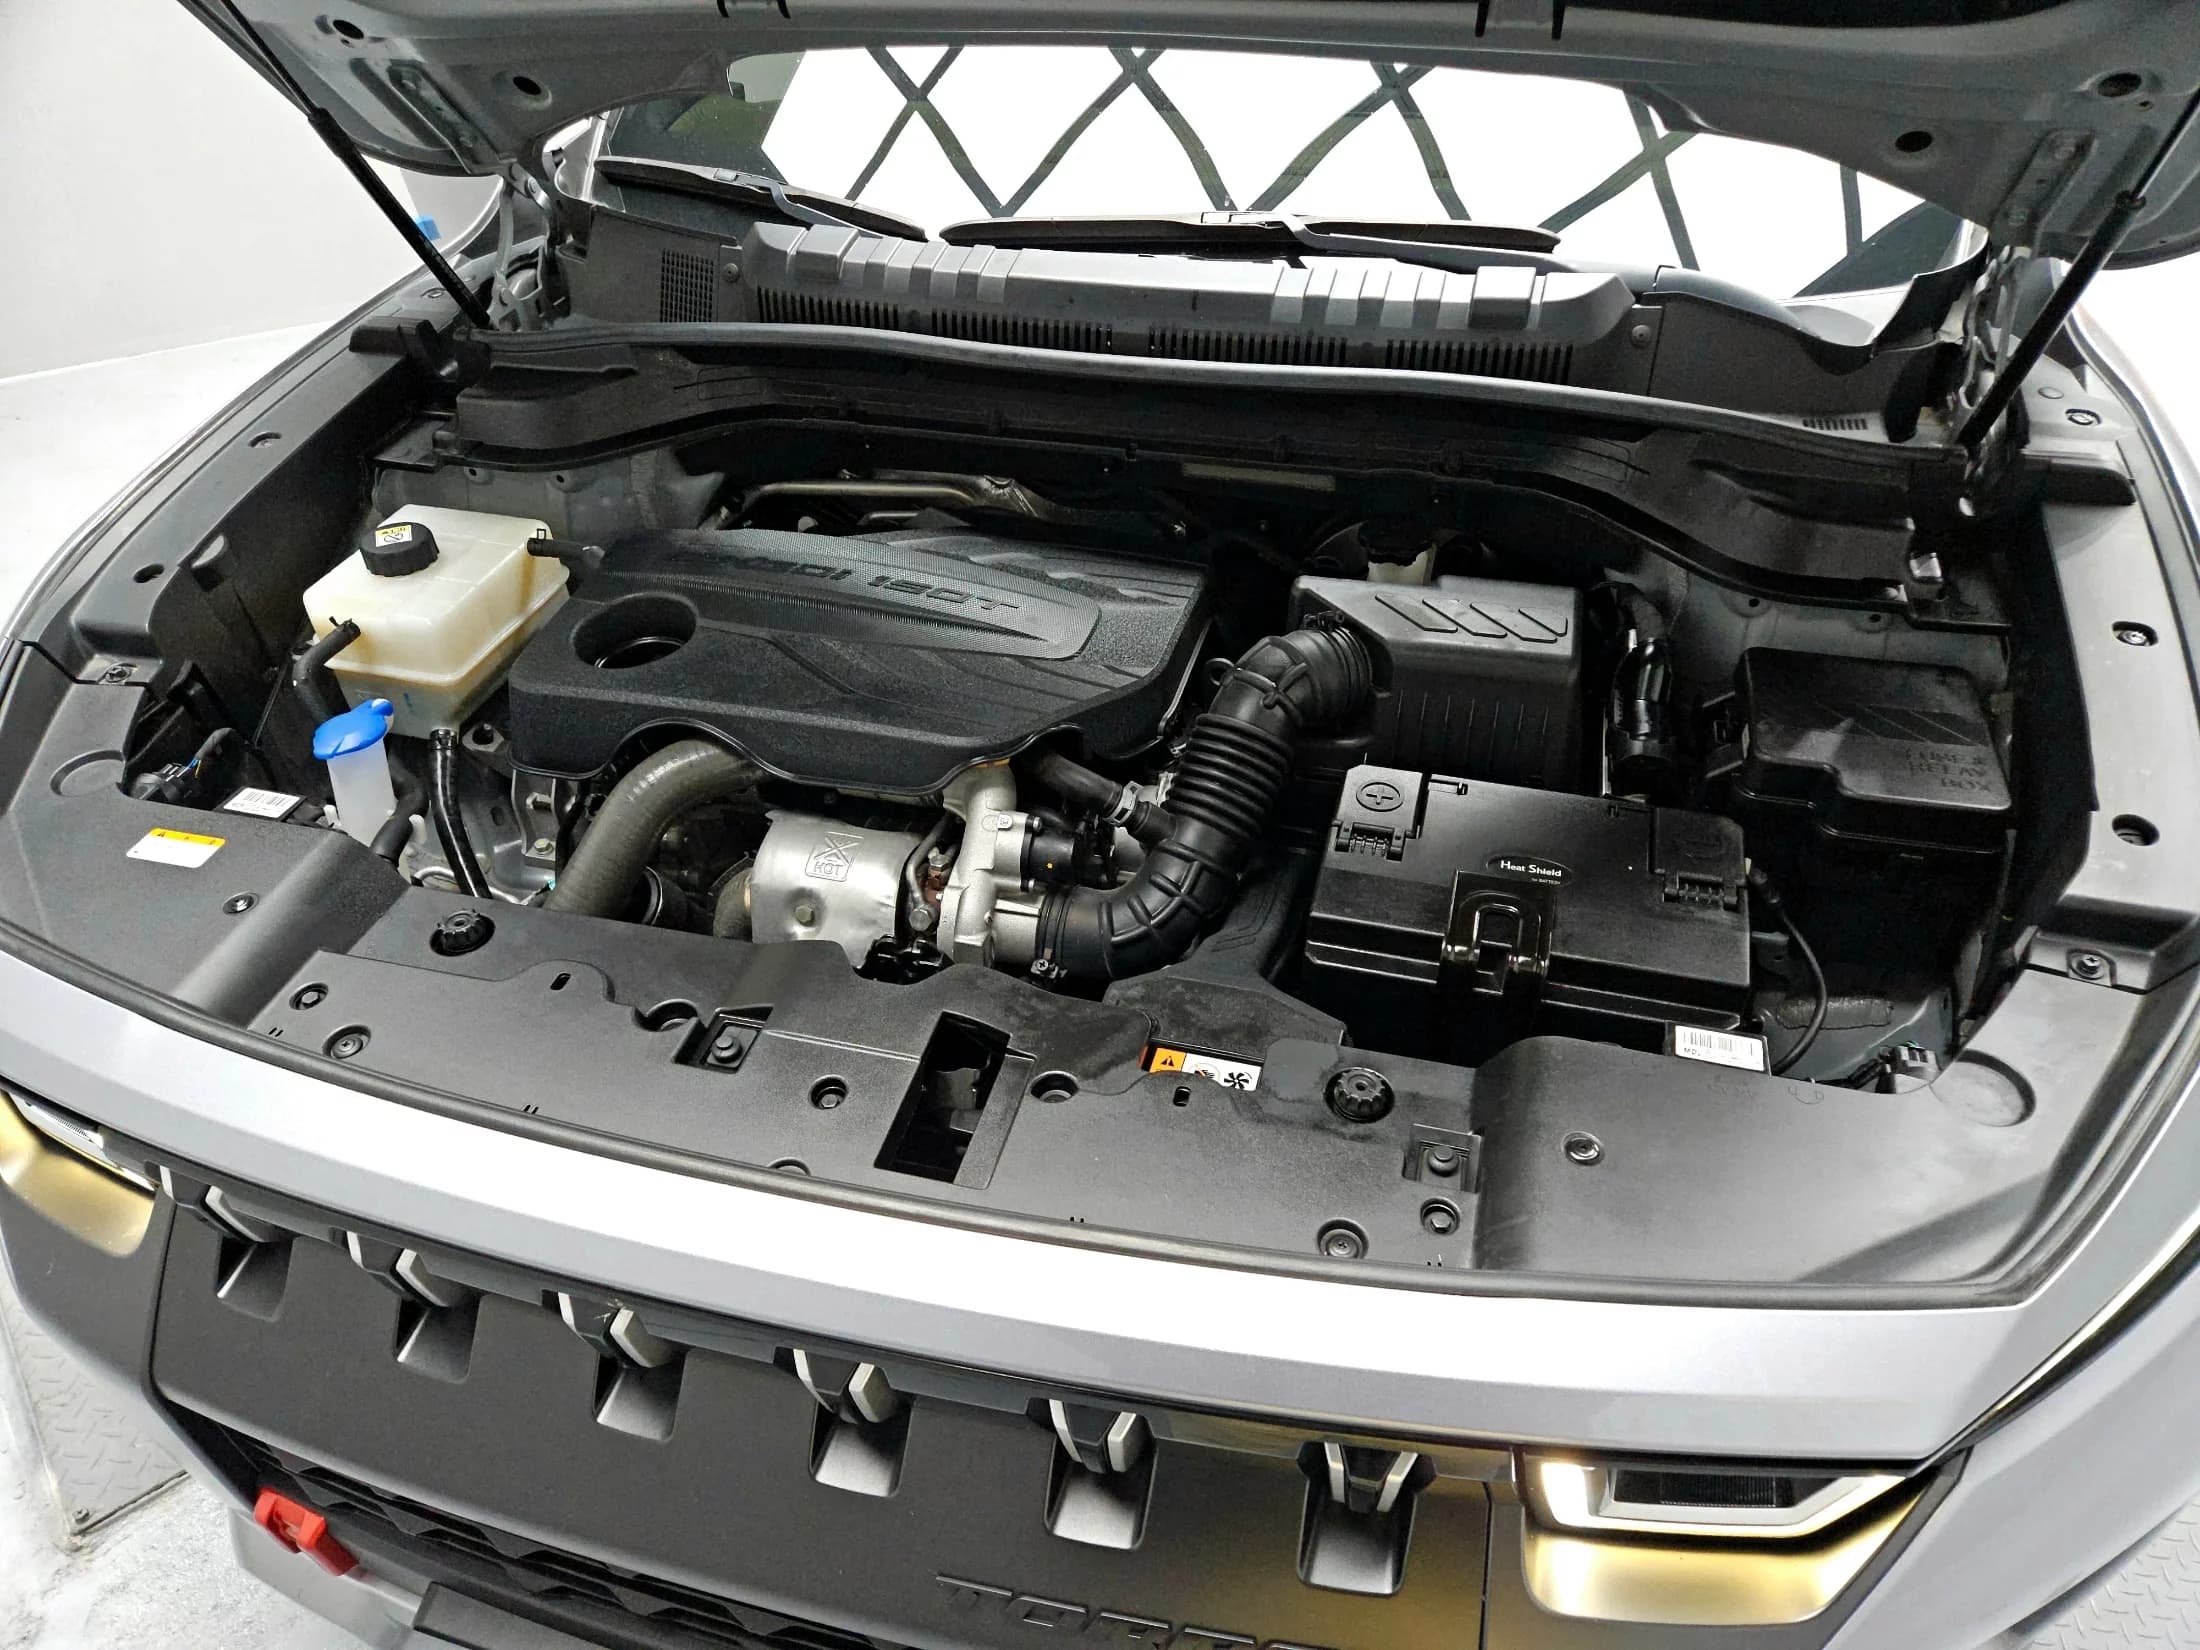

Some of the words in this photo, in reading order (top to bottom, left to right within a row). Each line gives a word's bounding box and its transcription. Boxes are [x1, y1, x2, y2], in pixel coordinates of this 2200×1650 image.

[814, 857, 843, 876] HOT
[1500, 859, 1526, 872] Heat
[1528, 864, 1562, 877] Shield
